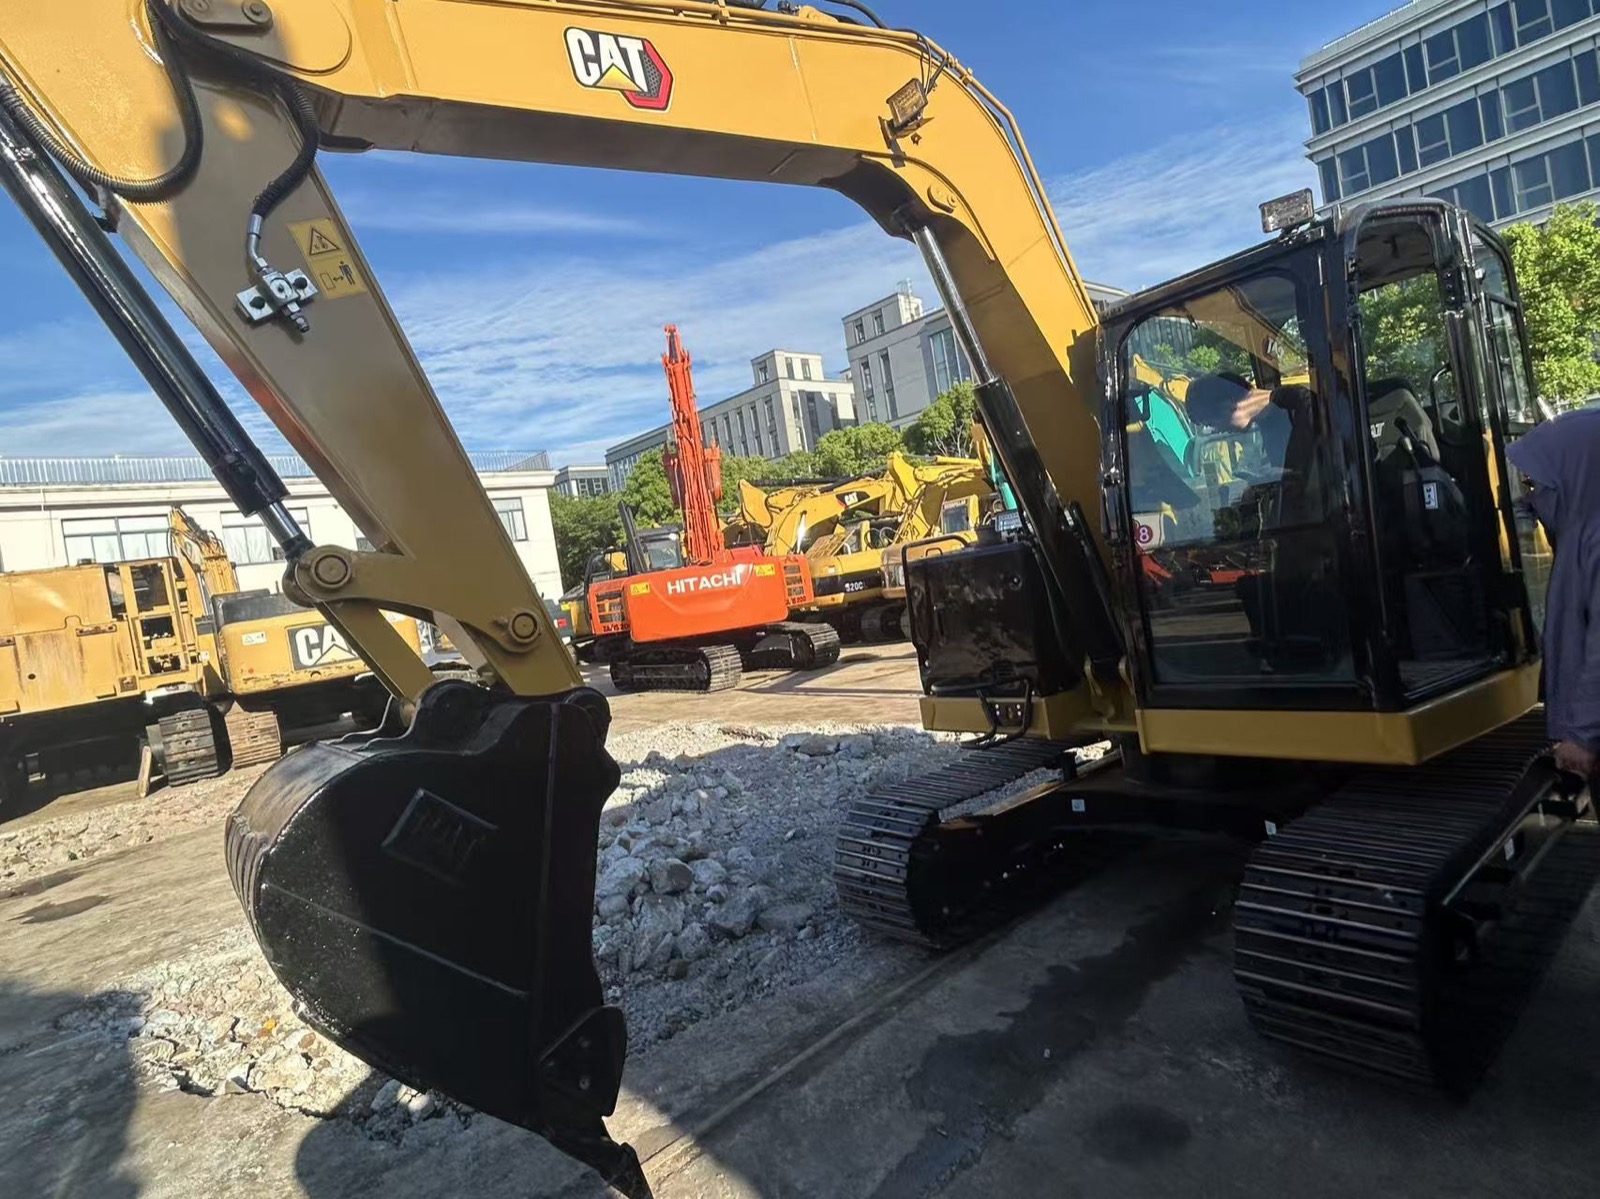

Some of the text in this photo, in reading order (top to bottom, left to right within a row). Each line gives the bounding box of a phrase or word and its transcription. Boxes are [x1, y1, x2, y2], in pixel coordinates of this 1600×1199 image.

[566, 28, 649, 92] CAT
[844, 491, 859, 506] CAT
[1139, 526, 1150, 542] 8
[666, 570, 742, 595] HITACHI
[295, 624, 357, 666] CA
